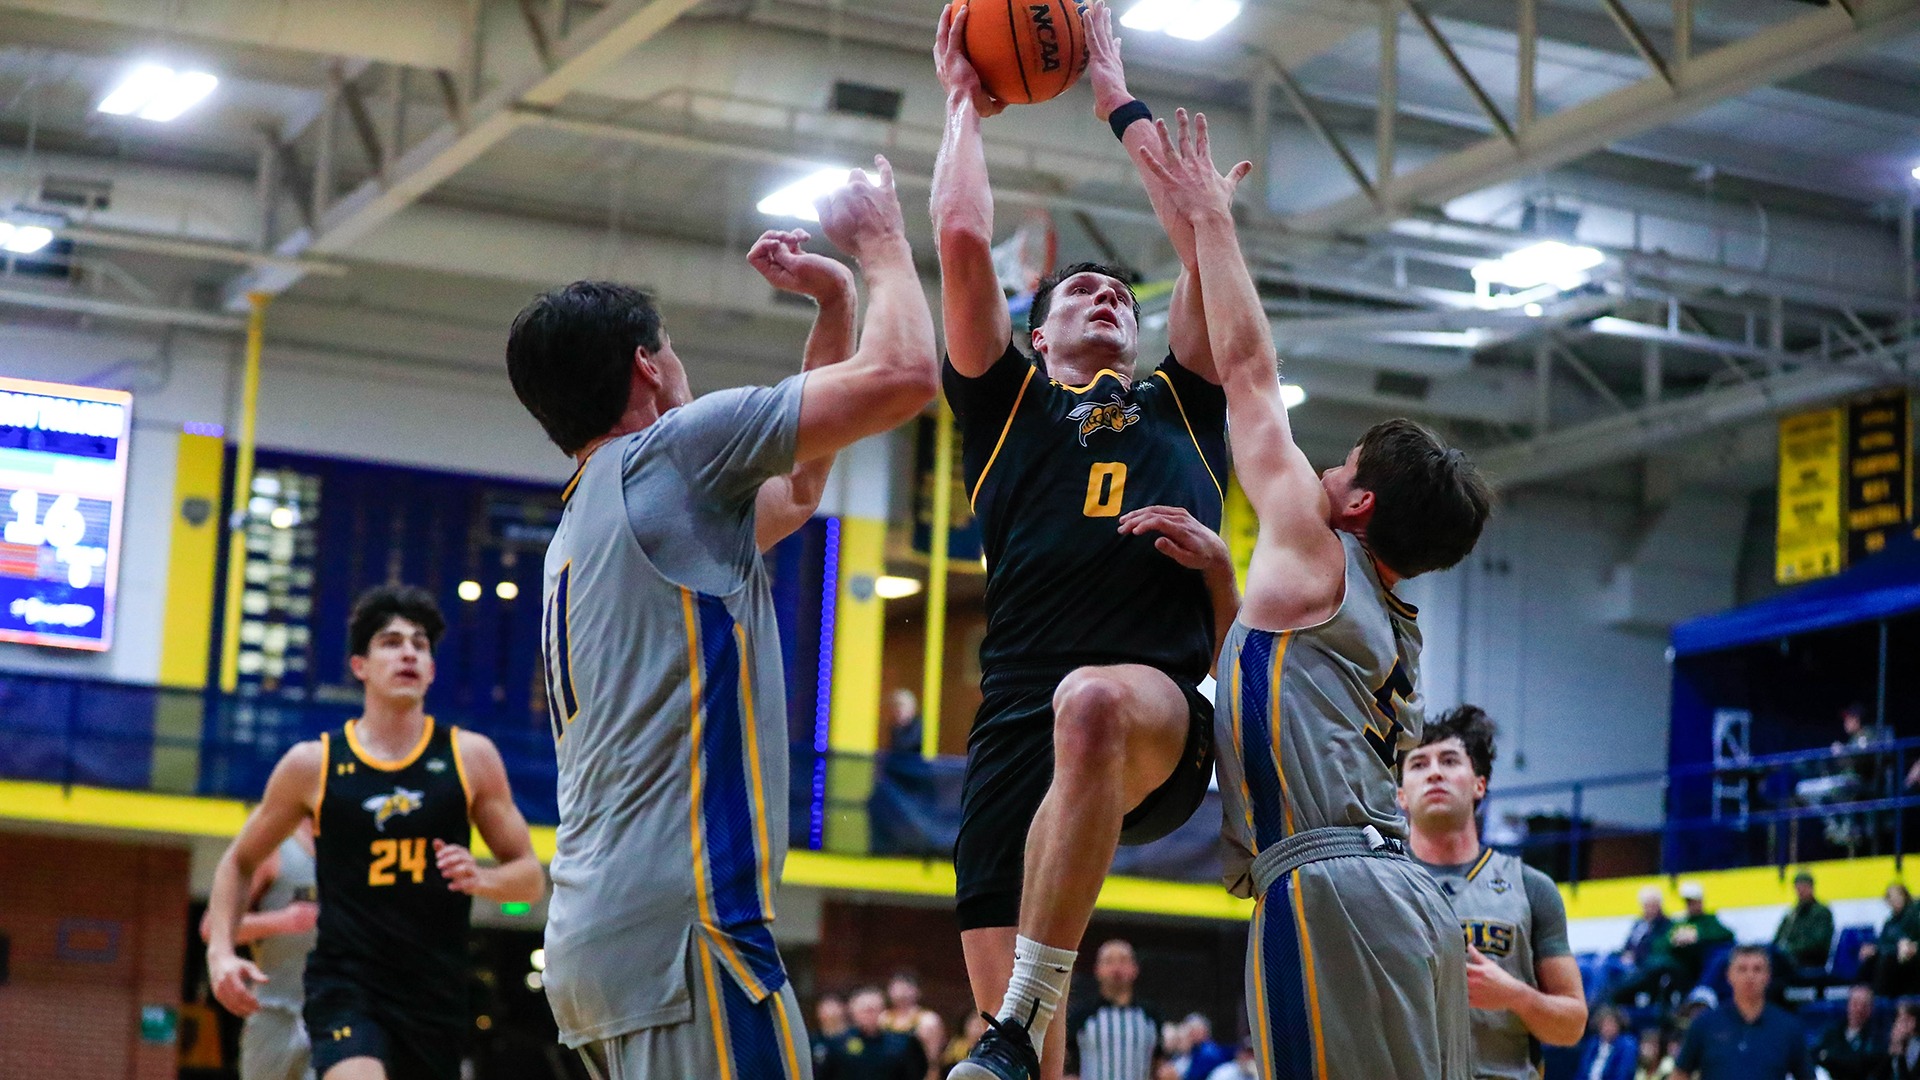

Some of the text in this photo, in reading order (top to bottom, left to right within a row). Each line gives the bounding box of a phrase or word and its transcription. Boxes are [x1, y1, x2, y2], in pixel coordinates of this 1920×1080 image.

[1029, 4, 1060, 73] NCAA
[4, 489, 86, 547] 16
[1082, 461, 1127, 518] 0
[545, 557, 580, 744] 11
[368, 837, 428, 886] 24
